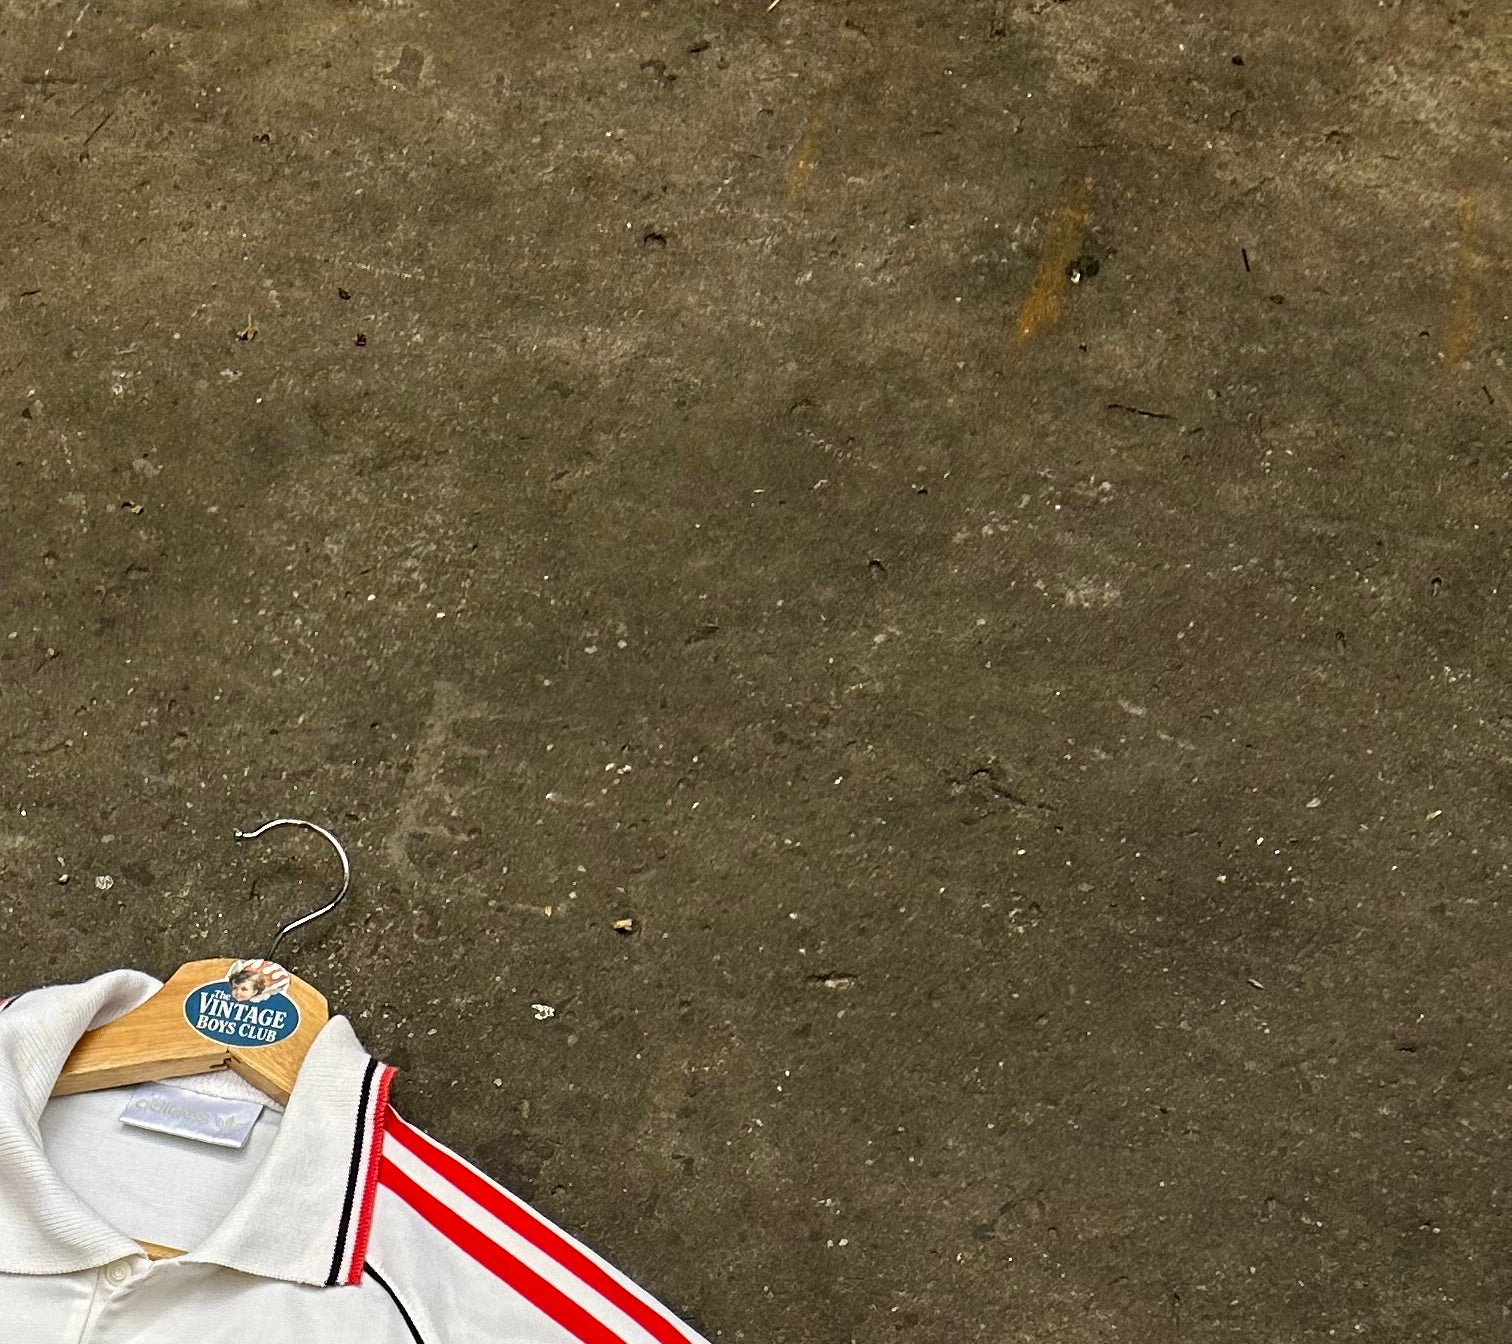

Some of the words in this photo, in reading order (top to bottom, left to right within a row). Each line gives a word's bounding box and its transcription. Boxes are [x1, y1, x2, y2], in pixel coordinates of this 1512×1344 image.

[214, 990, 231, 1001] The
[199, 993, 286, 1029] VINTAGE
[197, 1015, 235, 1035] BOYS
[238, 1022, 276, 1043] CLUB
